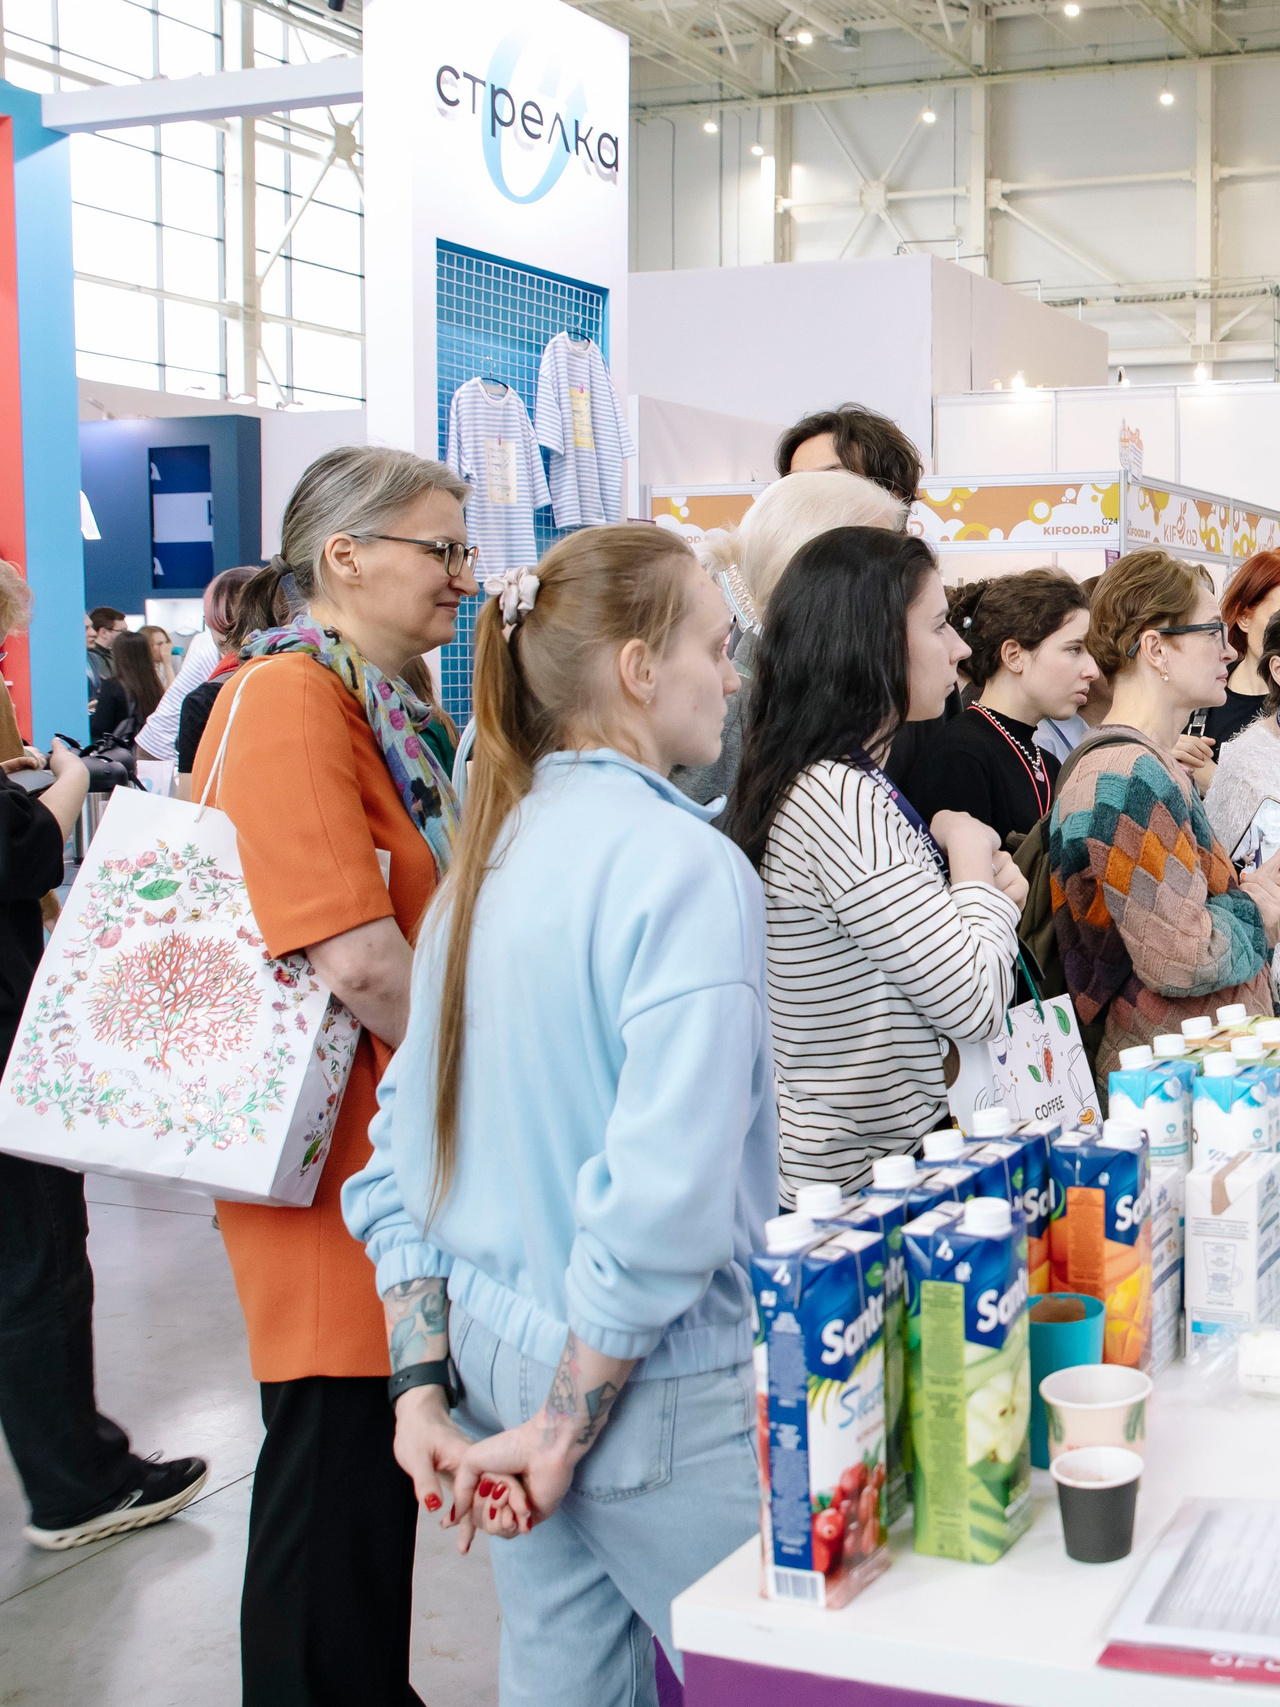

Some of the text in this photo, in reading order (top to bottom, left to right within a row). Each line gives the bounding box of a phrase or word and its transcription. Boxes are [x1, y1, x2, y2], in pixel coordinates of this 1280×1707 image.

[436, 65, 618, 172] стрелка
[1043, 525, 1110, 536] KIFOOD.RU
[1101, 517, 1118, 526] C24
[870, 768, 894, 793] BWT
[1035, 1095, 1066, 1121] COFFEE
